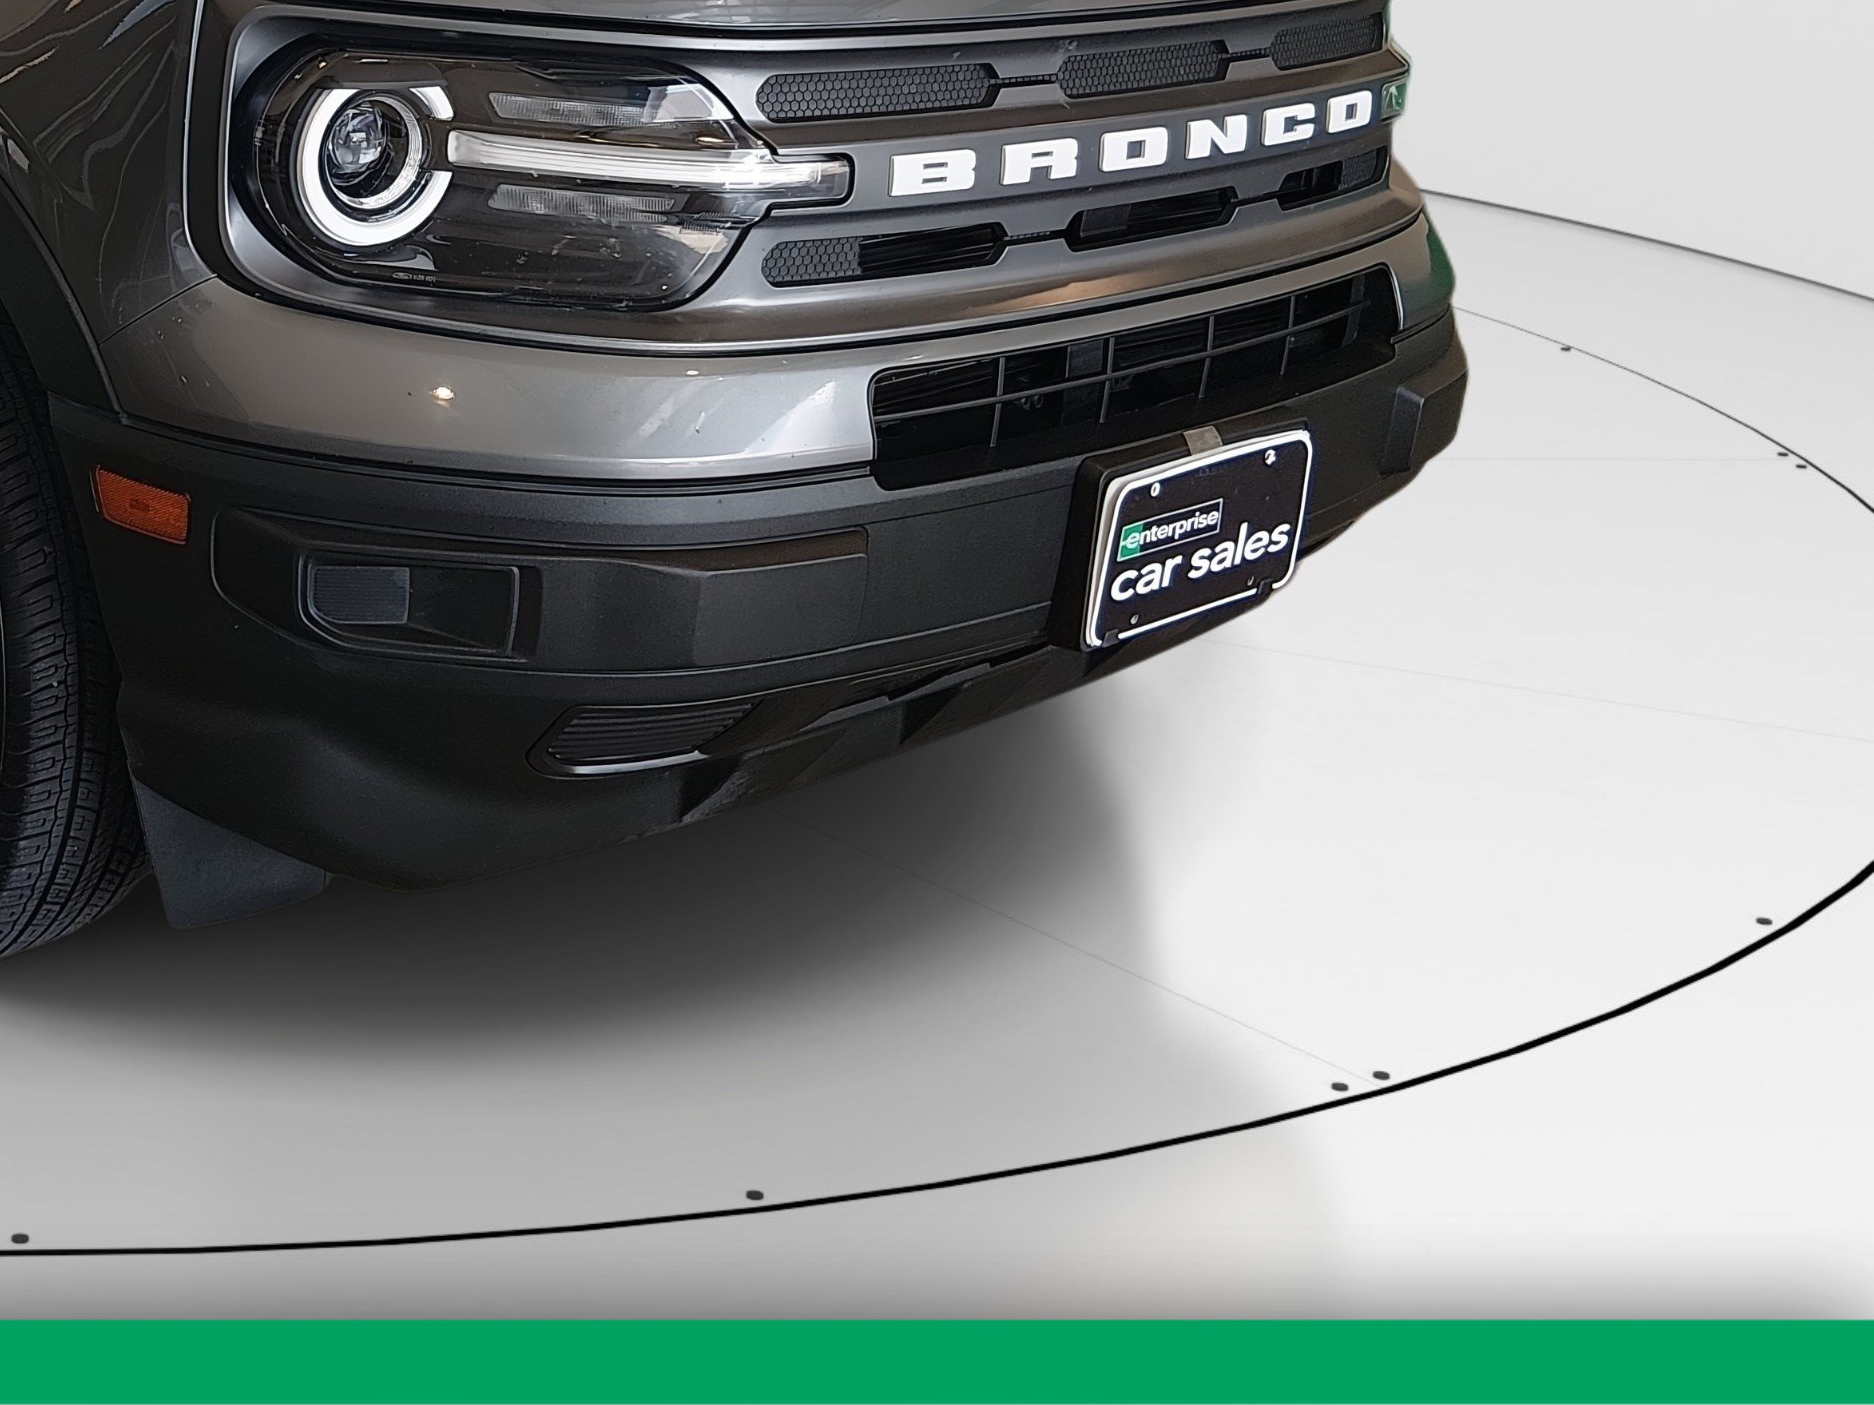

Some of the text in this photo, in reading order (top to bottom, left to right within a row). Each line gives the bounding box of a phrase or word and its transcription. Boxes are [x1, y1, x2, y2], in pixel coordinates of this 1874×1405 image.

[888, 89, 1374, 198] BRONCO
[1110, 522, 1291, 602] car sales
[1123, 510, 1219, 549] enterprise
